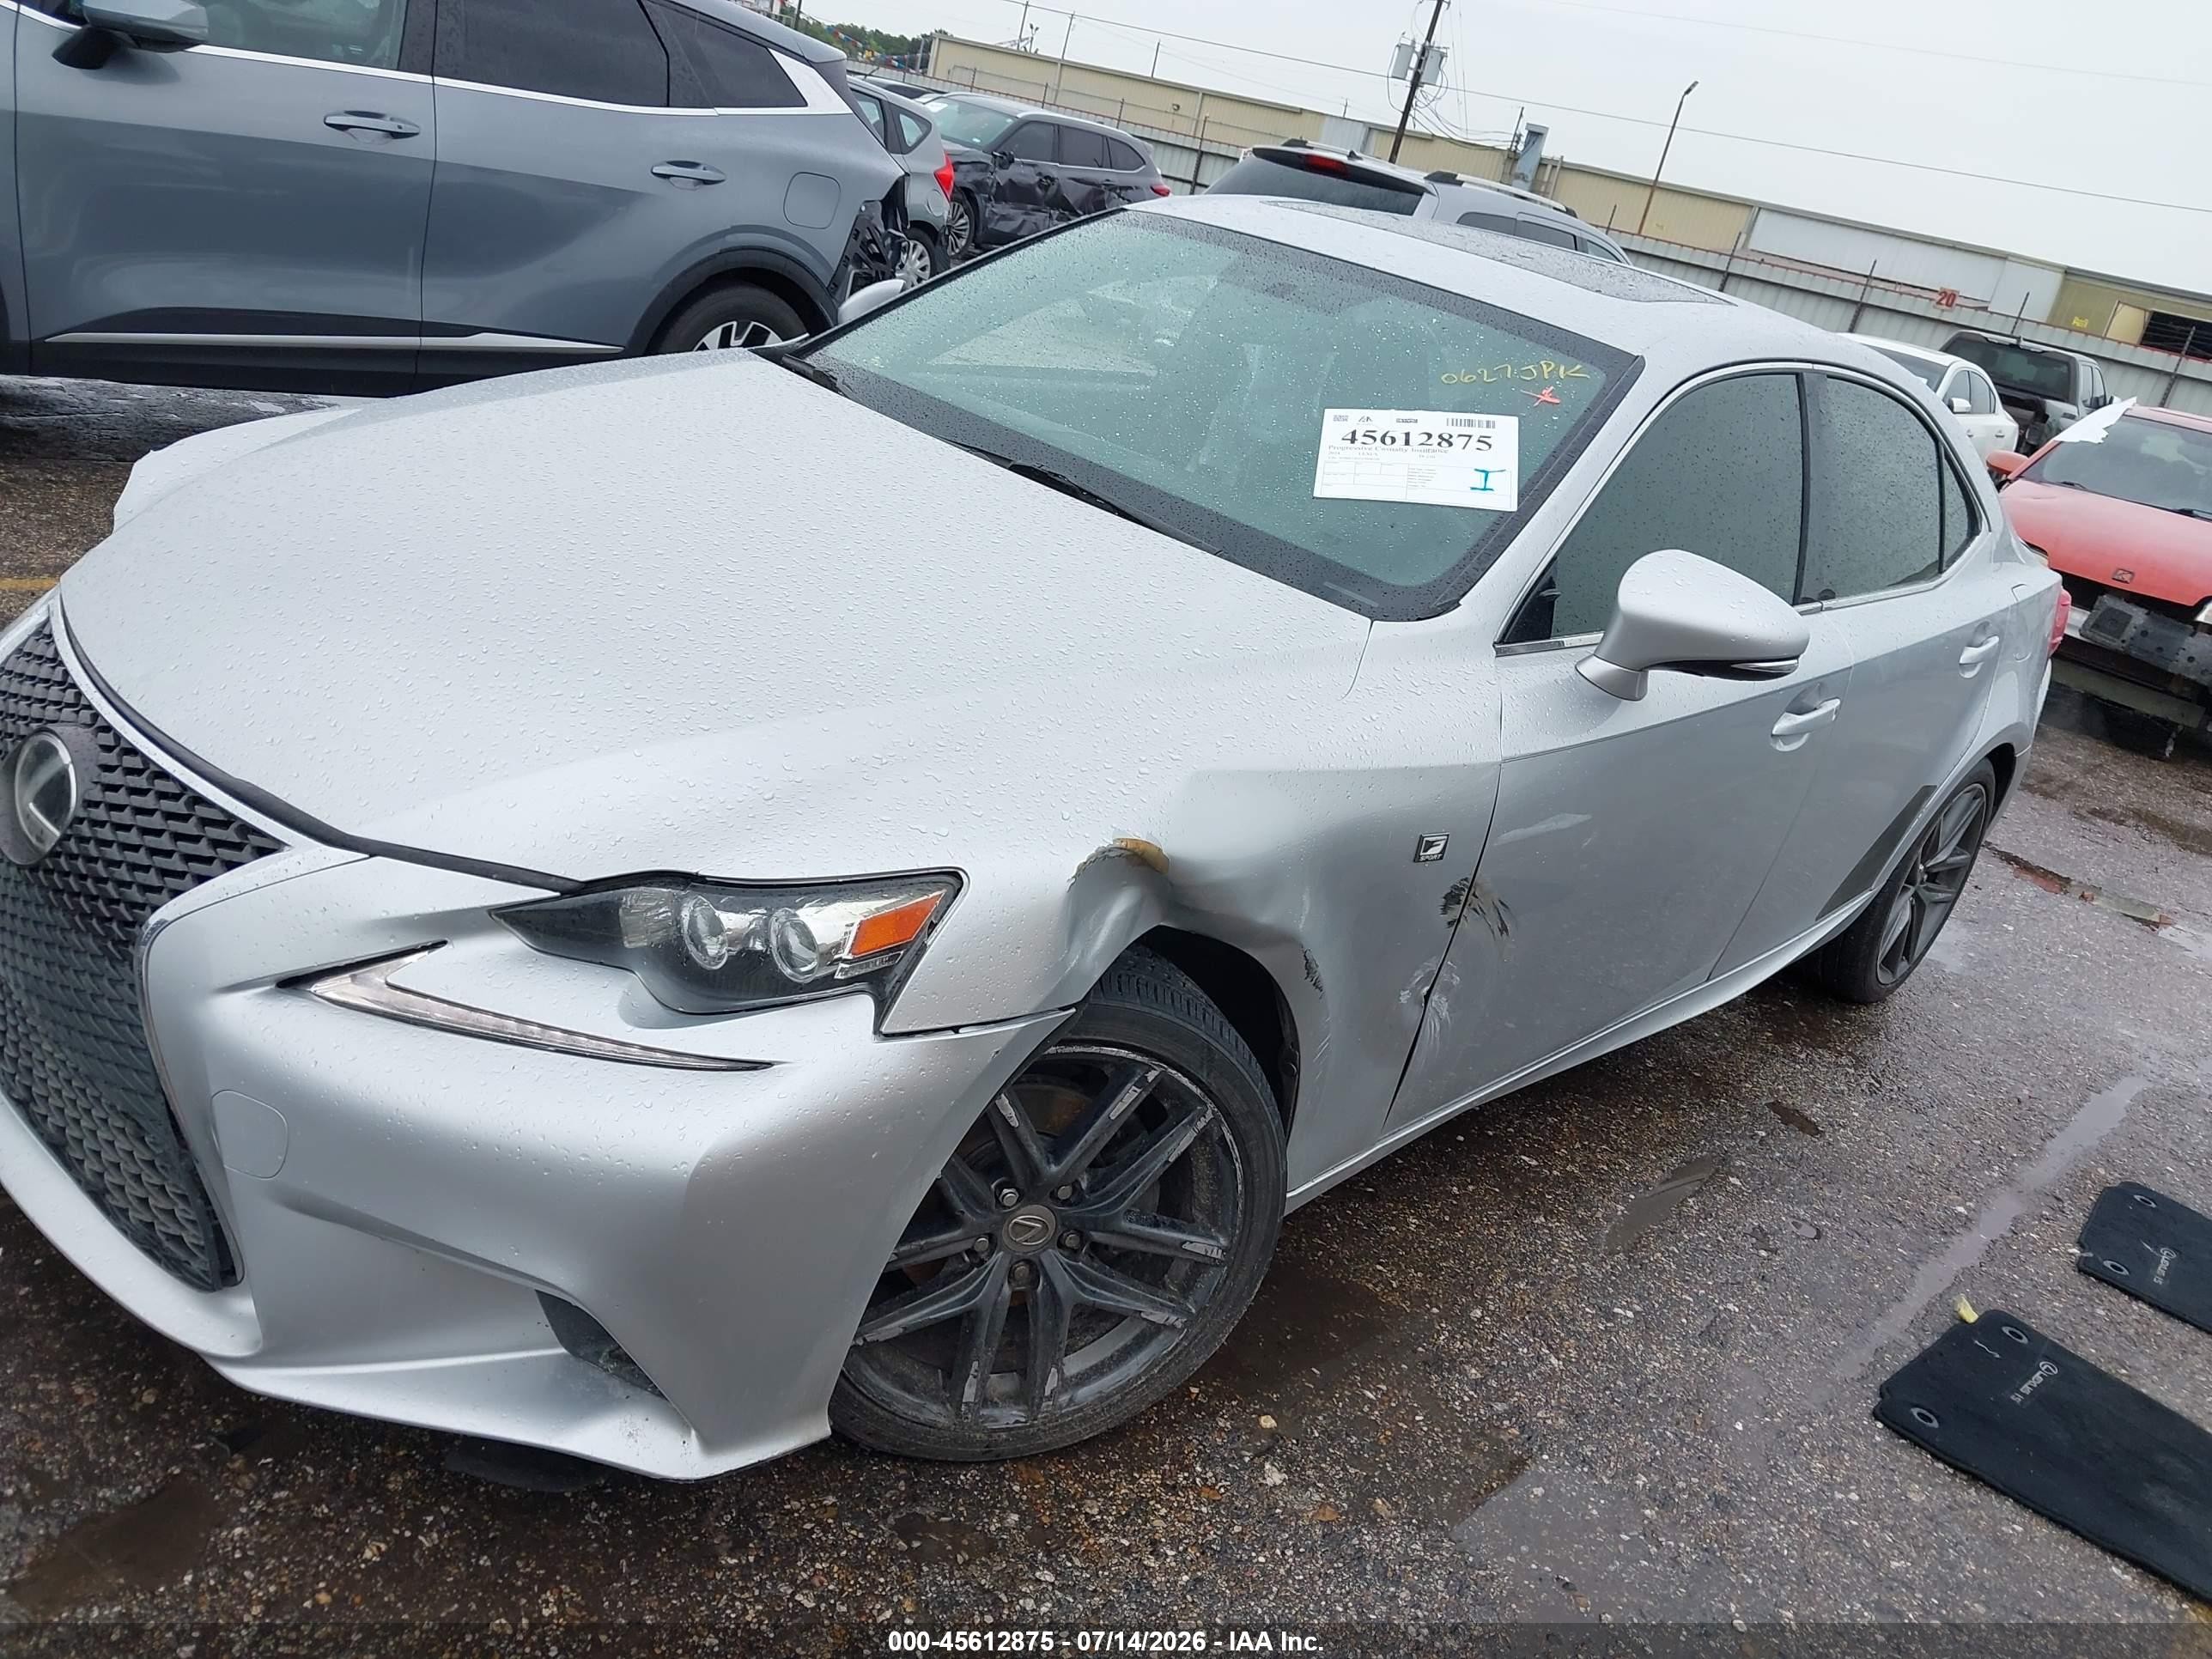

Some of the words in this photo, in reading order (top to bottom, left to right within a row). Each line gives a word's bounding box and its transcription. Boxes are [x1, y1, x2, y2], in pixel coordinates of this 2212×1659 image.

[1936, 291, 1956, 307] 20
[1341, 428, 1492, 451] 45612875
[2020, 1370, 2048, 1395] LEXUS
